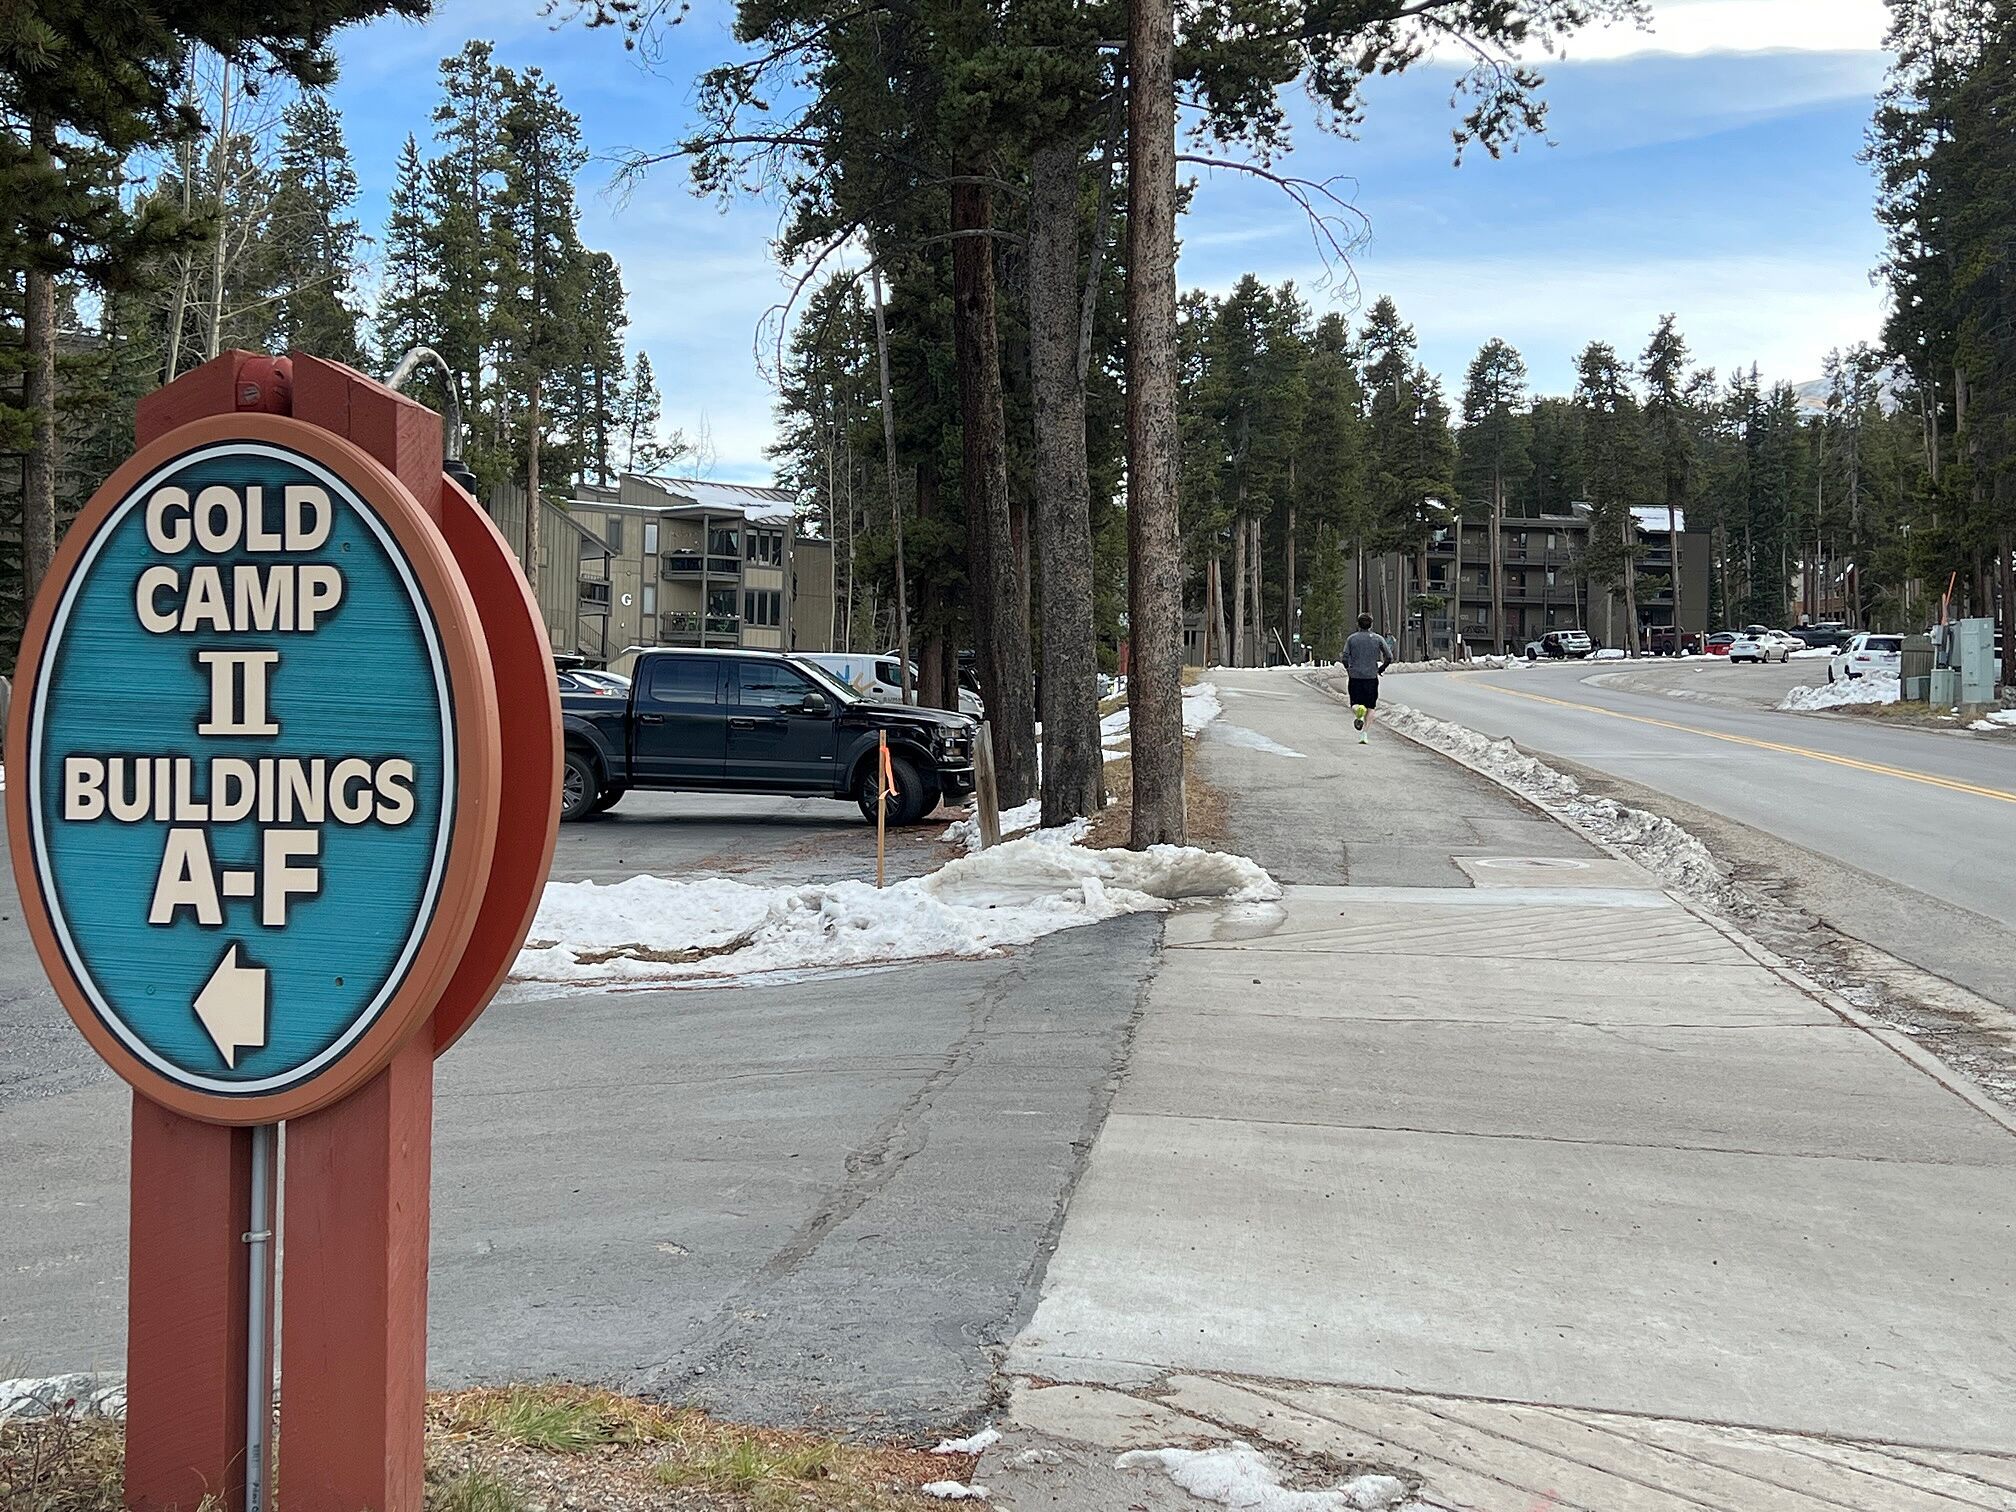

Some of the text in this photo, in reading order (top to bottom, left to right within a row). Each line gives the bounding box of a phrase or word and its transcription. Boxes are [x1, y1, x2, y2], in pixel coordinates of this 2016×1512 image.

[146, 486, 332, 552] GOLD
[136, 565, 342, 632] CAMP
[621, 593, 632, 606] G
[199, 651, 278, 735] II
[64, 757, 415, 824] BUILDINGS
[148, 828, 319, 926] A-F
